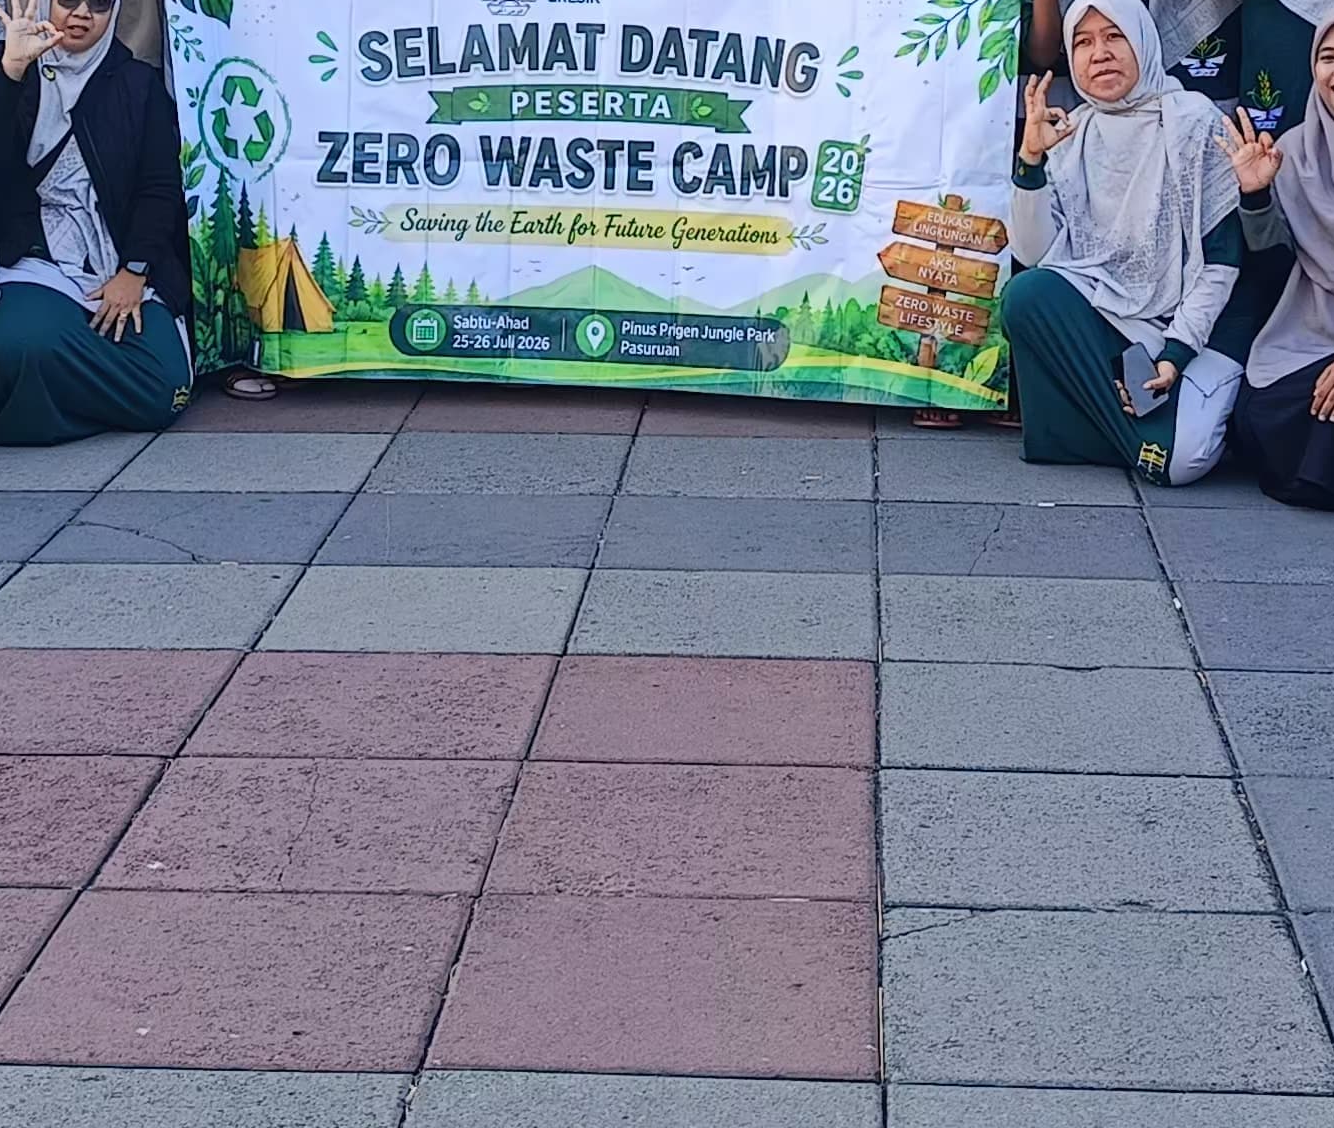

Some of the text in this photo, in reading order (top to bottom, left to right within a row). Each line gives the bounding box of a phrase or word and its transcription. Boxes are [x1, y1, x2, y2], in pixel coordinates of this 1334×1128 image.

[358, 22, 820, 93] SELAMAT DATANG
[509, 90, 672, 119] PESERTA
[316, 131, 808, 199] ZERO WASTE CAMP
[824, 146, 860, 175] 20
[817, 176, 854, 204] 26
[400, 207, 781, 249] Saving the Earth for Future Generations
[927, 212, 972, 229] EDUKASI
[913, 223, 984, 245] LINGKUNGAN
[929, 256, 956, 271] AKSI
[918, 267, 958, 286] NYATA
[896, 295, 975, 323] ZERO WASTE
[453, 315, 529, 331] Sabtu-Ahad
[620, 320, 776, 344] Pinus Prigen Jungle Park
[899, 312, 964, 336] LIFESTYLE
[453, 335, 551, 351] 25-26 Juli 2026
[620, 342, 680, 358] Pasuruan
